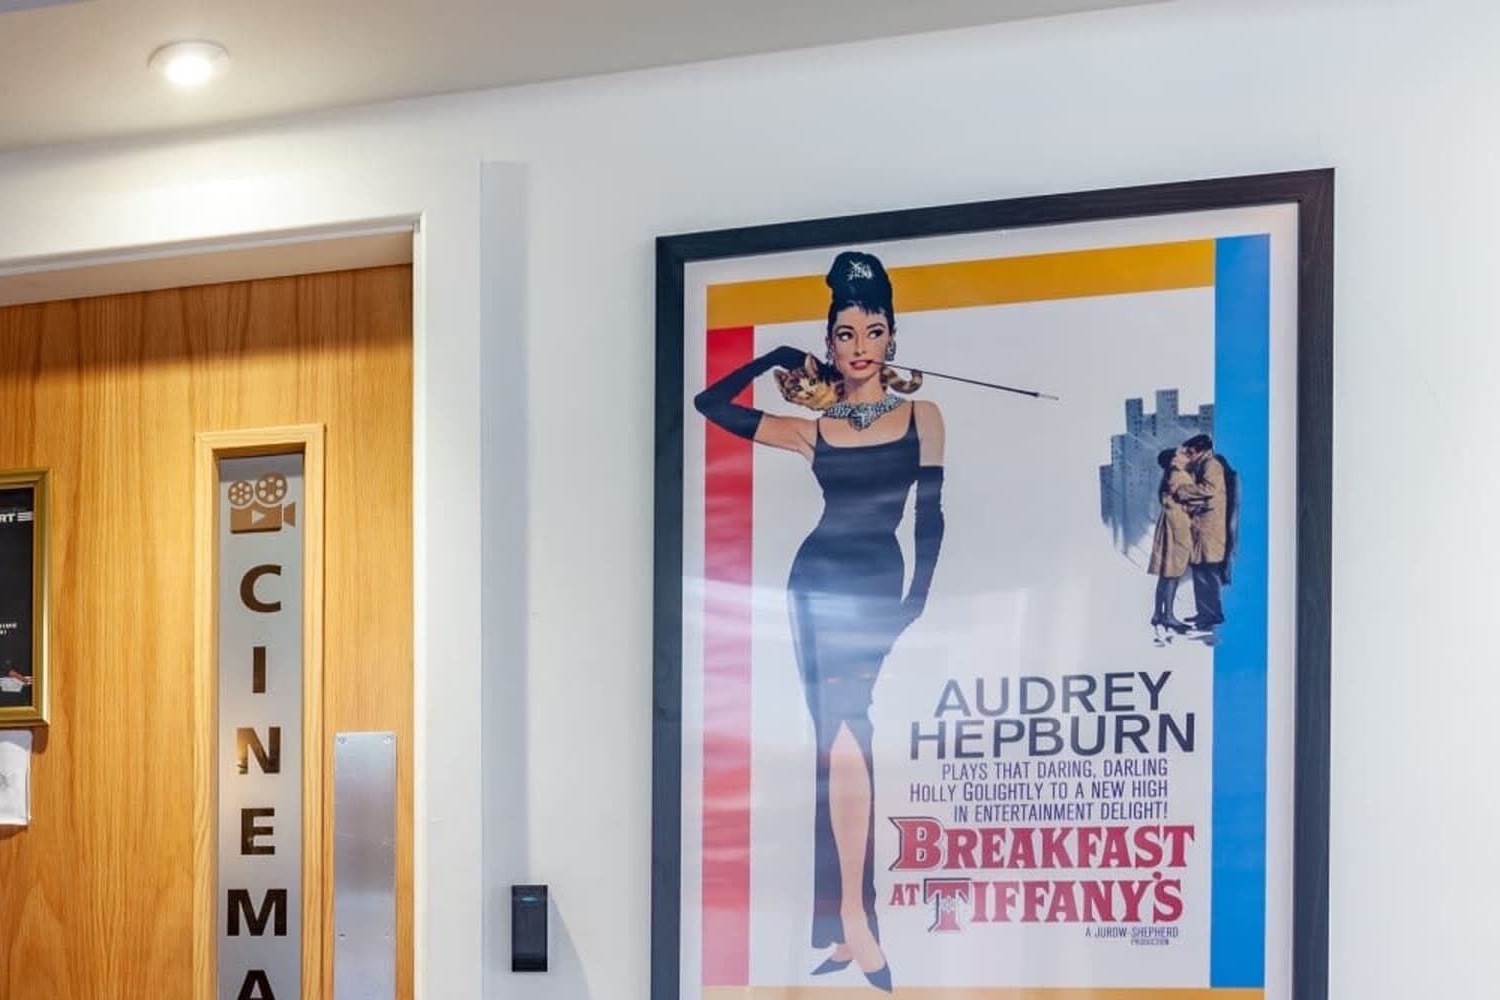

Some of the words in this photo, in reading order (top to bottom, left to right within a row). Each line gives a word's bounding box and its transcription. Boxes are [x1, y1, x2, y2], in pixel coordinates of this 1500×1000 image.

[933, 670, 1173, 719] AUDREY
[909, 712, 1196, 761] HEPBURN
[942, 762, 988, 781] PLAYS
[996, 761, 1032, 780] THAT
[1037, 759, 1097, 779] DARING,
[1103, 758, 1168, 777] DARLING
[910, 783, 957, 802] HOLLY
[963, 781, 1044, 801] GOLIGHTLY
[1051, 781, 1068, 799] TO
[1075, 781, 1085, 799] A
[1091, 780, 1126, 799] NEW
[1131, 779, 1168, 798] HIGH
[954, 804, 968, 823] IN
[975, 802, 1093, 822] ENTERTAINMENT
[1101, 801, 1168, 820] DELIGHT!
[888, 816, 1196, 872] BREAKFAST
[888, 883, 920, 906] AT
[923, 871, 1184, 933] TIFFANY'S
[1085, 926, 1092, 938] A
